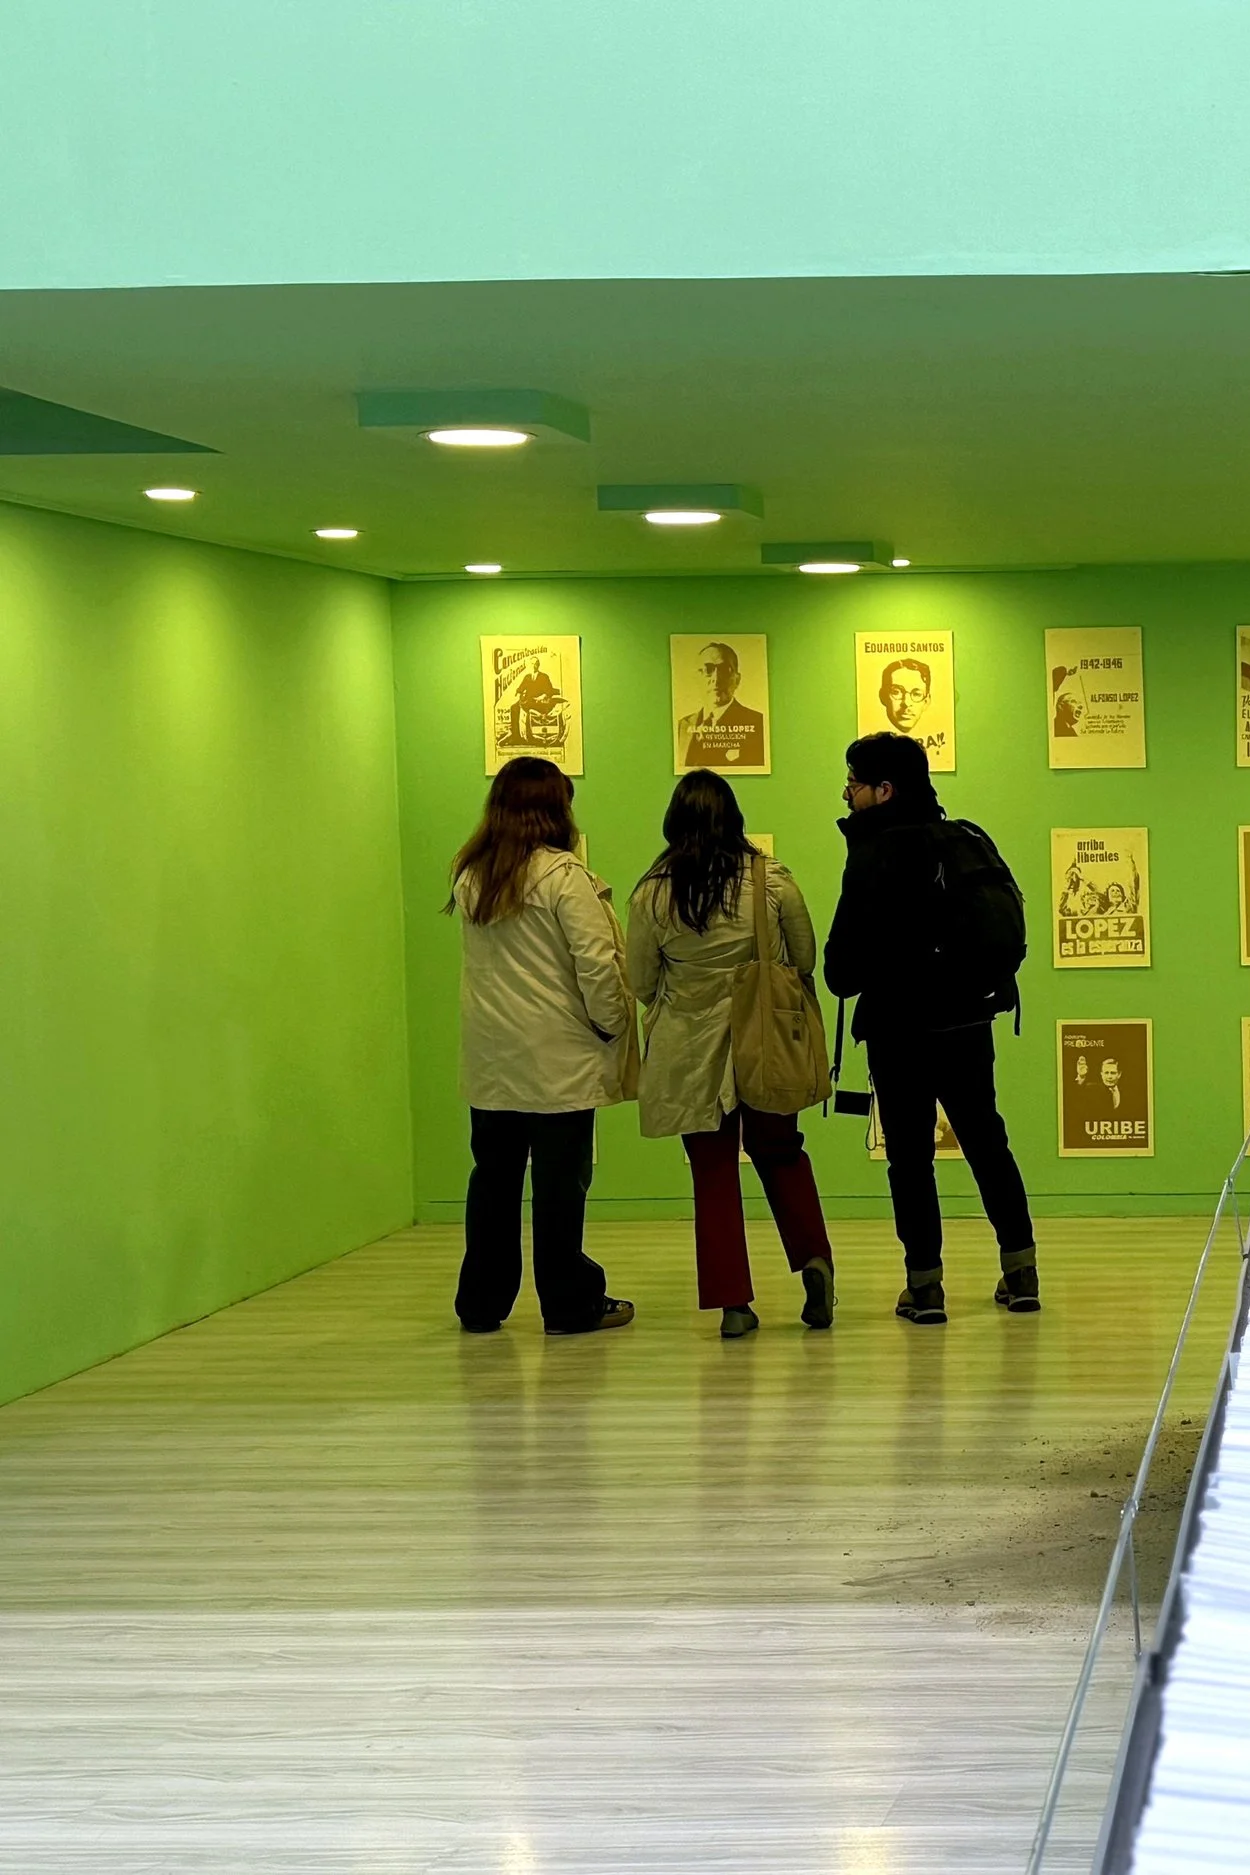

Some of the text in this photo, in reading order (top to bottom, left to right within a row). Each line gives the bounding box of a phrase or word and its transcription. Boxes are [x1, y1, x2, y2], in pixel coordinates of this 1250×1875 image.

[864, 642, 945, 653] EDUARDO SANTOS
[1080, 658, 1123, 669] 1942-1946
[1090, 692, 1139, 703] ALFONSO LOPEZ
[728, 725, 756, 733] LOPEZ
[1077, 839, 1105, 851] arriba
[1077, 851, 1120, 864] liberales
[1065, 917, 1136, 940] LOPEZ
[1084, 1120, 1146, 1135] URIBE
